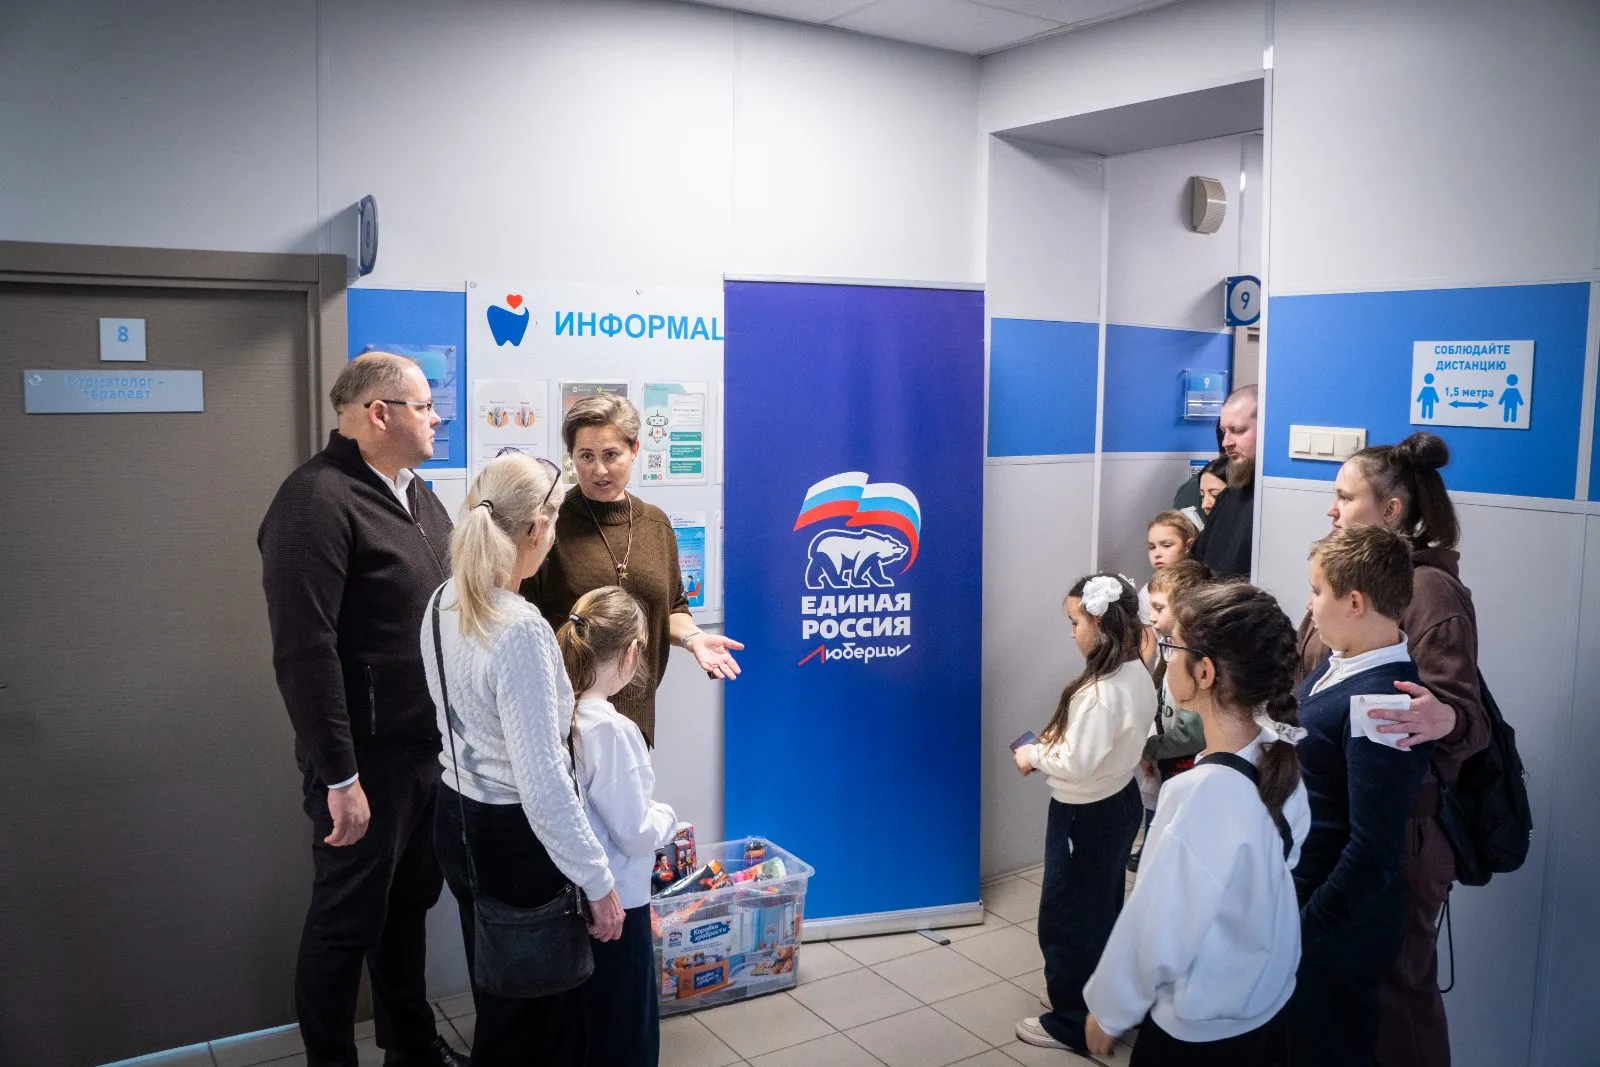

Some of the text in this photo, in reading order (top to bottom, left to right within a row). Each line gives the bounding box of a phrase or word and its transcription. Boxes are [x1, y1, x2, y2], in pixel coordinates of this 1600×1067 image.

[1241, 291, 1251, 310] 9
[118, 325, 129, 343] 8
[1434, 343, 1511, 356] СОБЛЮДАЙТЕ
[1435, 360, 1507, 372] ДИСТАНЦИЮ
[1203, 377, 1210, 389] 9
[83, 388, 151, 400] терапевт
[1445, 387, 1495, 399] 1,5 метра
[801, 592, 911, 616] ЕДИНАЯ
[802, 616, 911, 640] РОССИЯ
[797, 642, 912, 667] Люберцы
